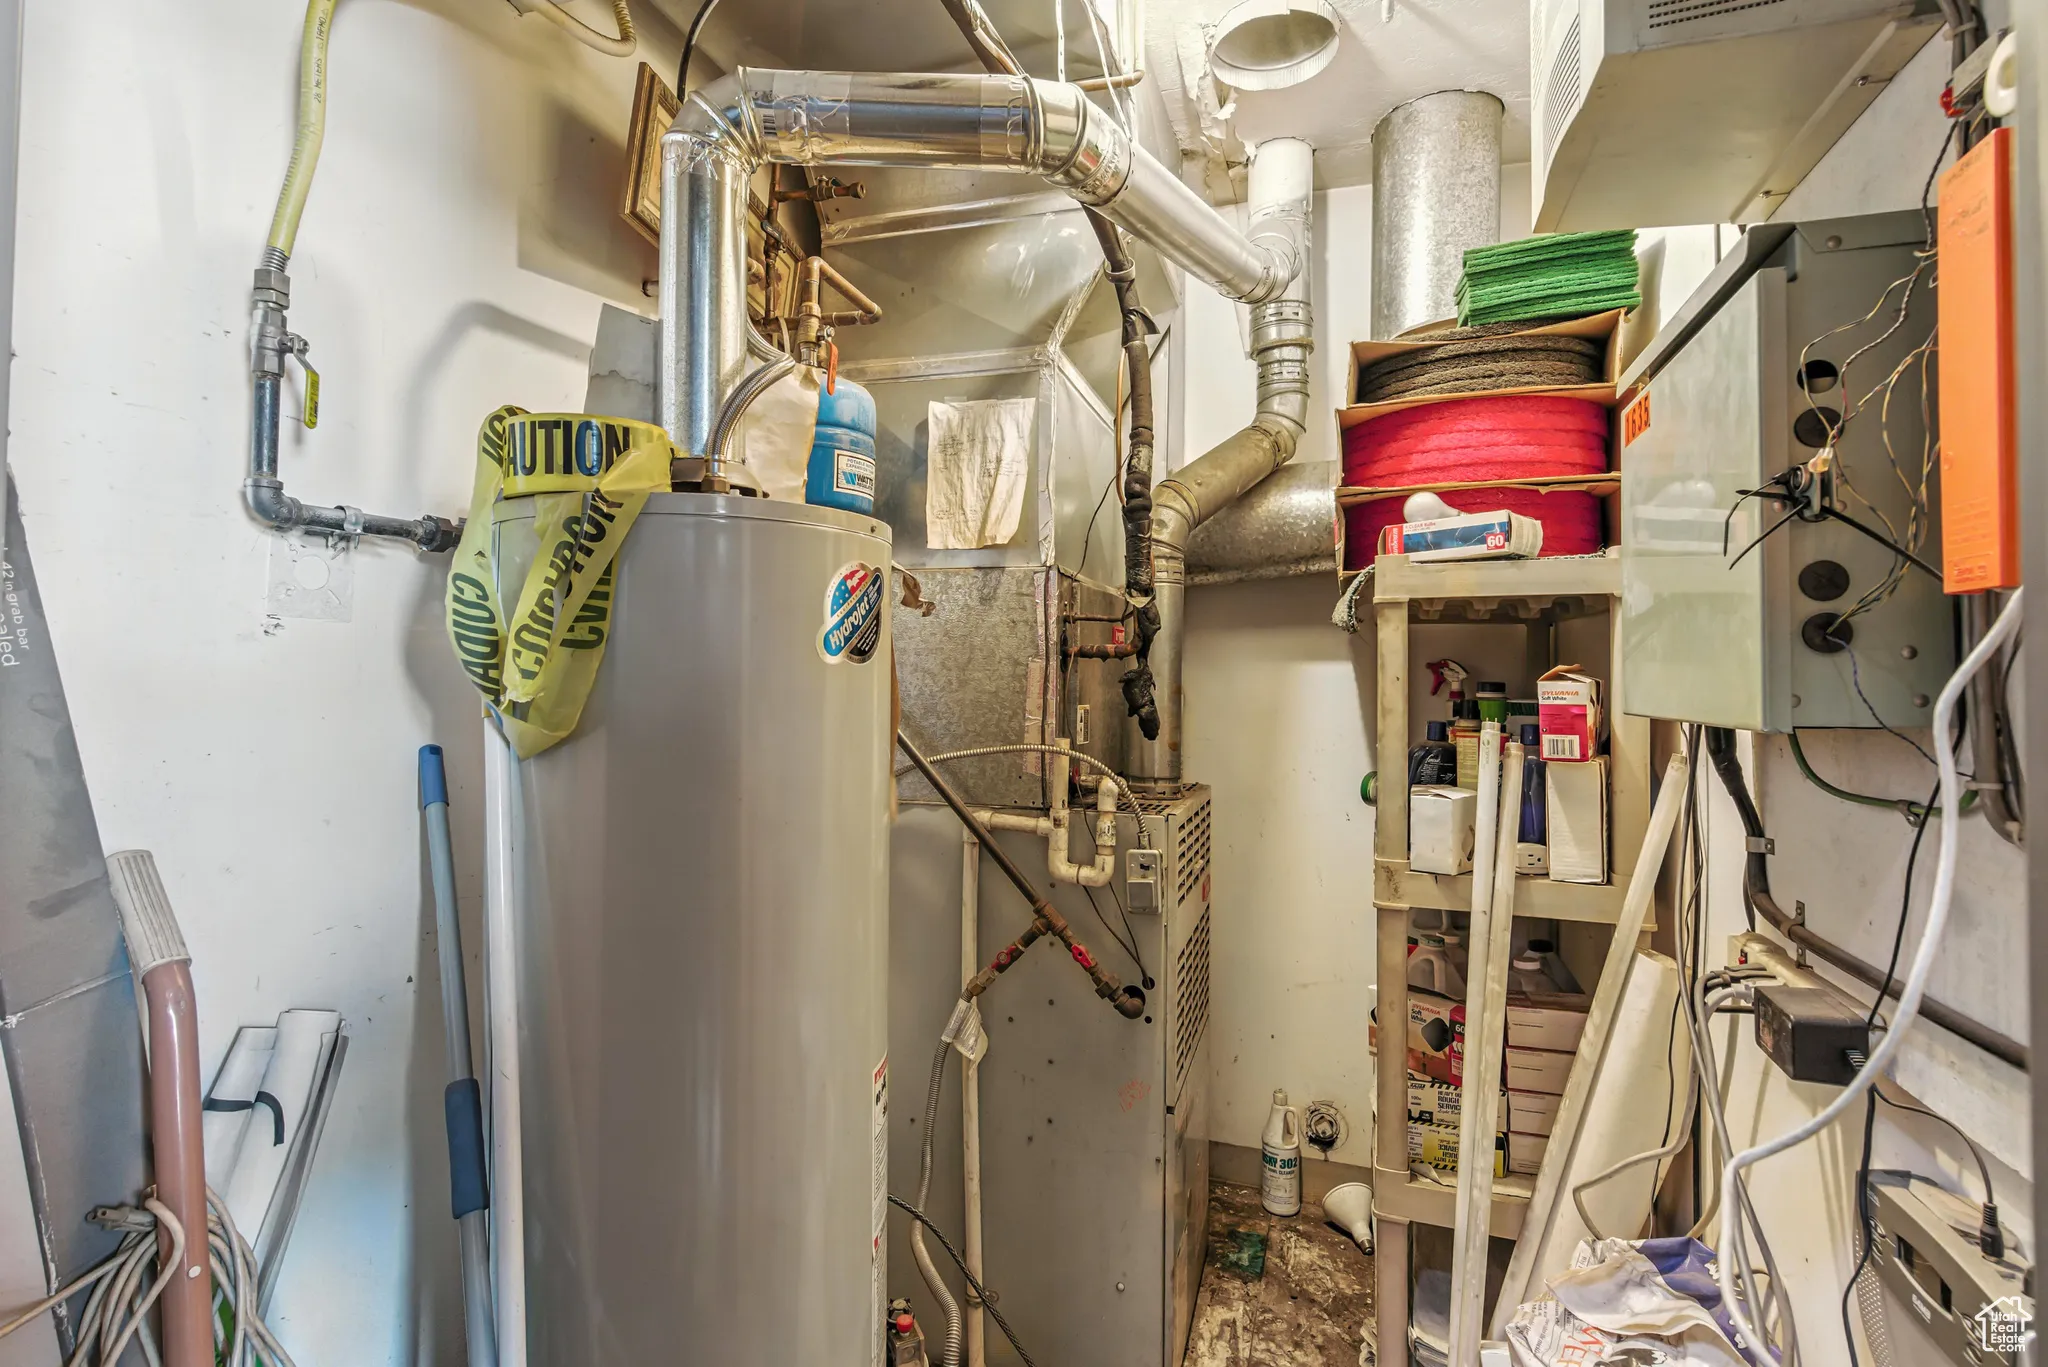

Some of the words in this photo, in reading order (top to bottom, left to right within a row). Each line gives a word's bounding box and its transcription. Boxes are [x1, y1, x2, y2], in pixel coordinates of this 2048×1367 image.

[504, 420, 631, 477] AUTION
[1487, 536, 1504, 547] 60
[6, 593, 24, 625] grab
[17, 628, 29, 650] bar
[829, 593, 870, 650] Hydrojet
[1437, 1096, 1460, 1104] ROUGH
[1437, 1103, 1461, 1111] SERVIC
[1438, 1144, 1459, 1152] ERVICE
[1280, 1157, 1298, 1169] 302
